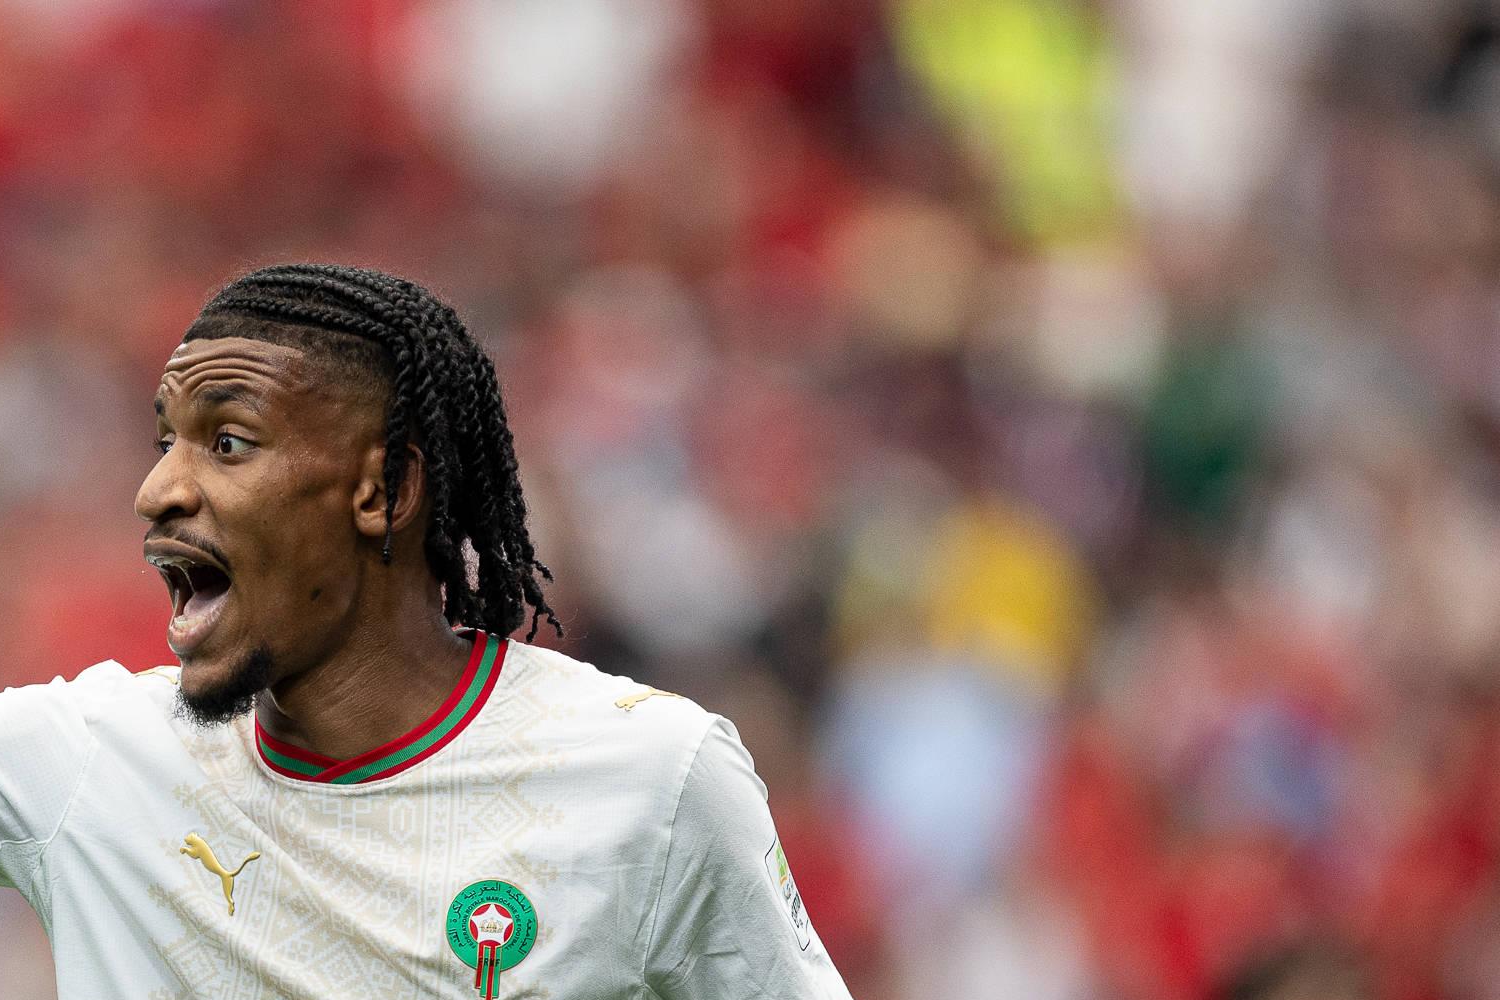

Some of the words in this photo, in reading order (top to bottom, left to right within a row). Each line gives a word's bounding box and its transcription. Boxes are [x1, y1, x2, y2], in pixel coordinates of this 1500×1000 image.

[466, 898, 484, 915] ROYALE
[486, 896, 518, 916] MAROCAINE
[505, 923, 522, 951] FOOTBALL
